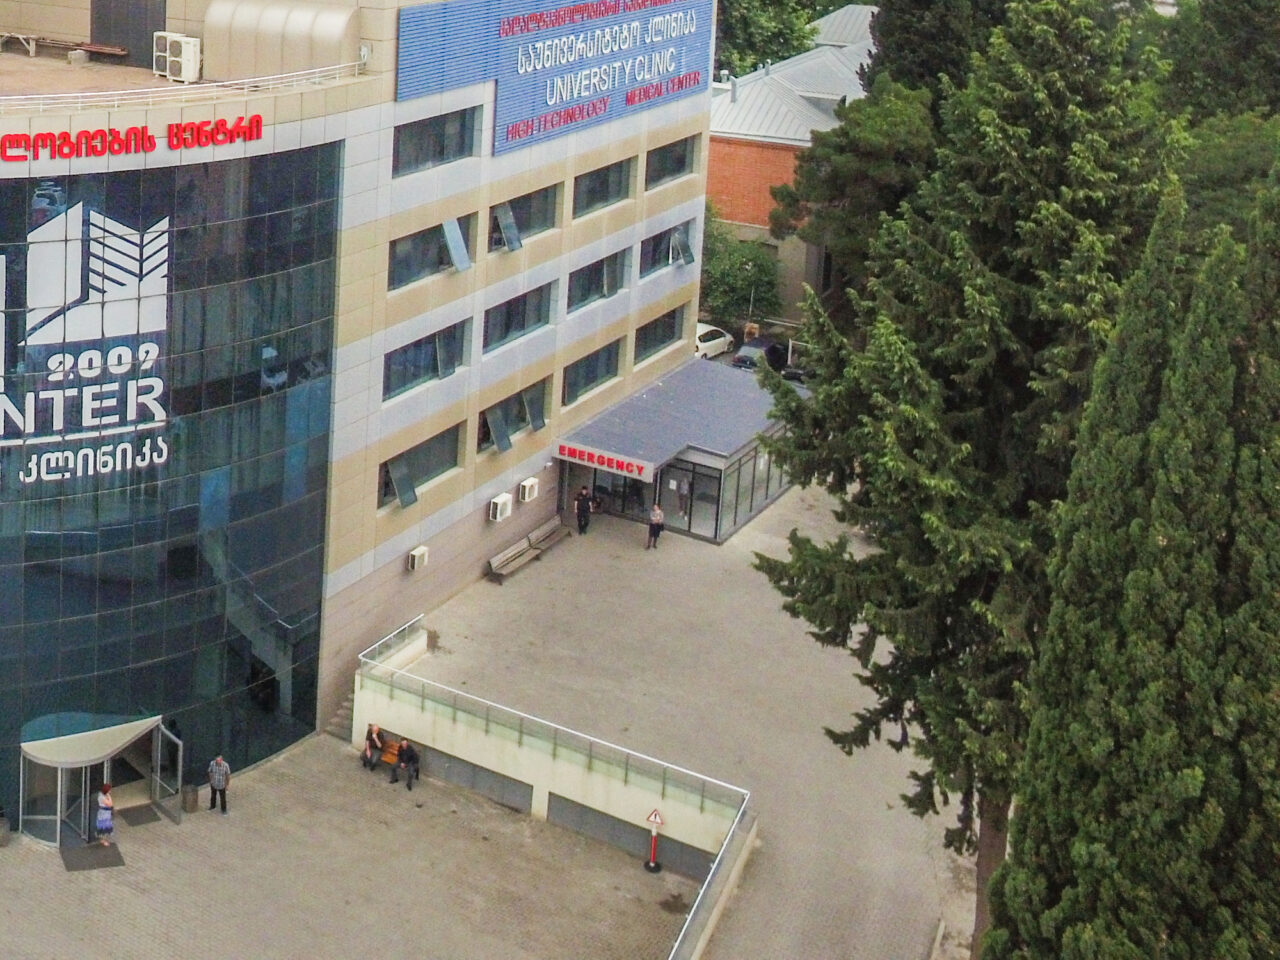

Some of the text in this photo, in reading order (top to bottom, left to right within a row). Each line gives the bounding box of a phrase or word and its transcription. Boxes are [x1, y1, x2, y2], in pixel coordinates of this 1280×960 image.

[517, 10, 696, 74] საუნივერსიტეტო კლინიკა
[546, 47, 676, 106] UNIVERSITY CLINIC
[506, 71, 701, 142] HIGH TECHNOLOGY MEDICAL CENTER
[167, 120, 263, 151] ცენტრი
[19, 436, 168, 484] კლინიკა
[559, 444, 645, 476] EMERGENCY
